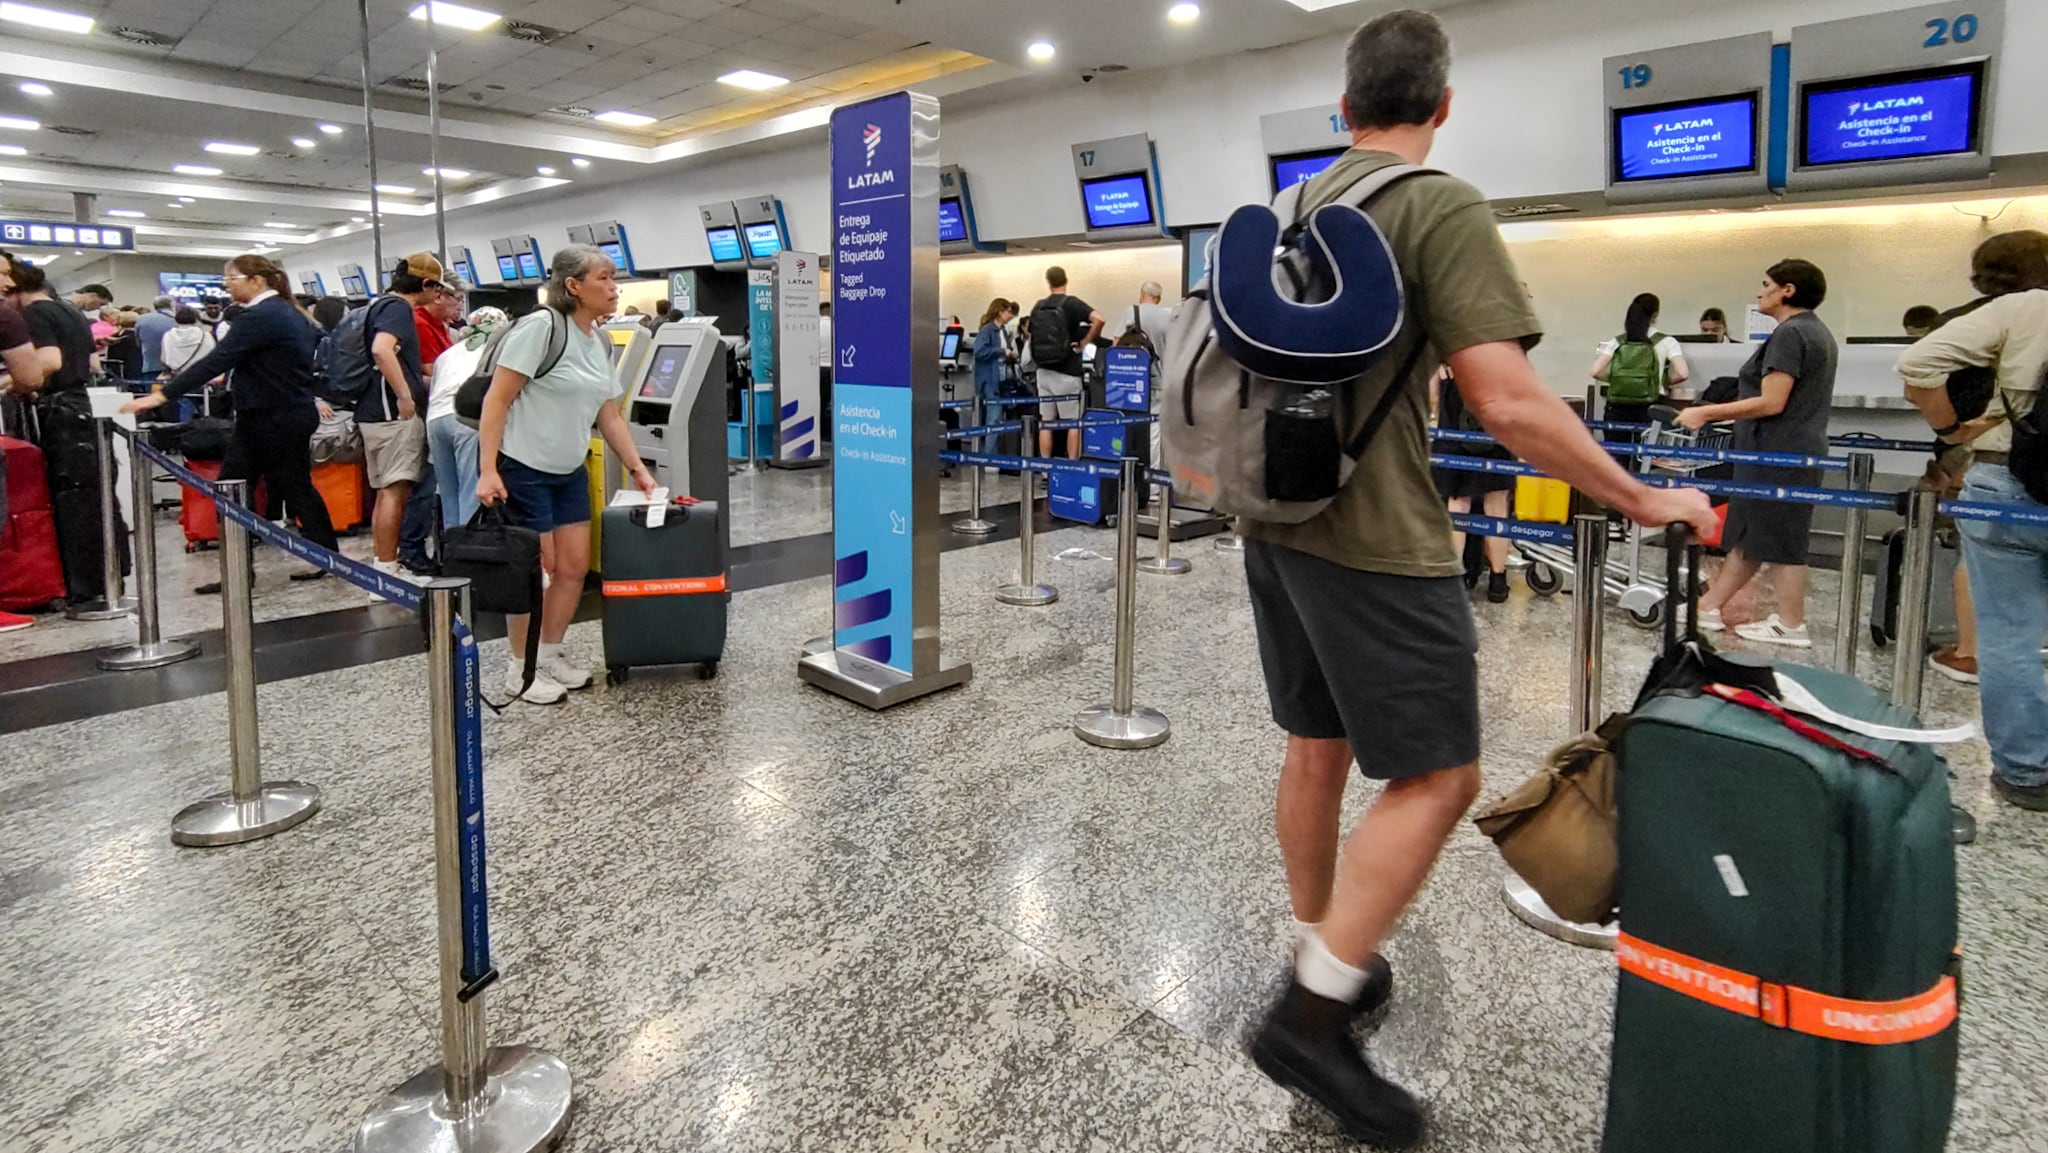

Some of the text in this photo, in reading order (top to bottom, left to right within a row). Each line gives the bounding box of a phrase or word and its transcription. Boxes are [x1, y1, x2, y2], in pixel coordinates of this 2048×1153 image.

[1923, 14, 1979, 48] 20
[1619, 64, 1652, 89] 19
[1863, 96, 1924, 111] LATAM
[1665, 118, 1714, 132] LATAM
[1839, 110, 1933, 130] Asistencia en el
[1858, 124, 1912, 137] Check-in
[1647, 131, 1722, 149] Asistencia en el
[1880, 135, 1927, 145] Assistance
[1662, 143, 1705, 155] Check-in
[1080, 150, 1095, 167] 17
[848, 169, 895, 190] LATAM
[839, 215, 871, 229] Entrega
[839, 229, 888, 246] de Equipaje
[839, 247, 885, 264] Etiquetado
[840, 272, 864, 287] Tagged
[840, 286, 887, 301] Baggage Drop
[840, 404, 881, 419] Asistencia
[840, 422, 897, 438] en el Check-in
[870, 451, 907, 466] Assistance
[1791, 491, 1834, 500] despegar
[1951, 505, 2002, 517] despegar
[1511, 525, 1555, 538] despegar
[465, 657, 474, 719] despegar
[470, 834, 479, 894] despegar
